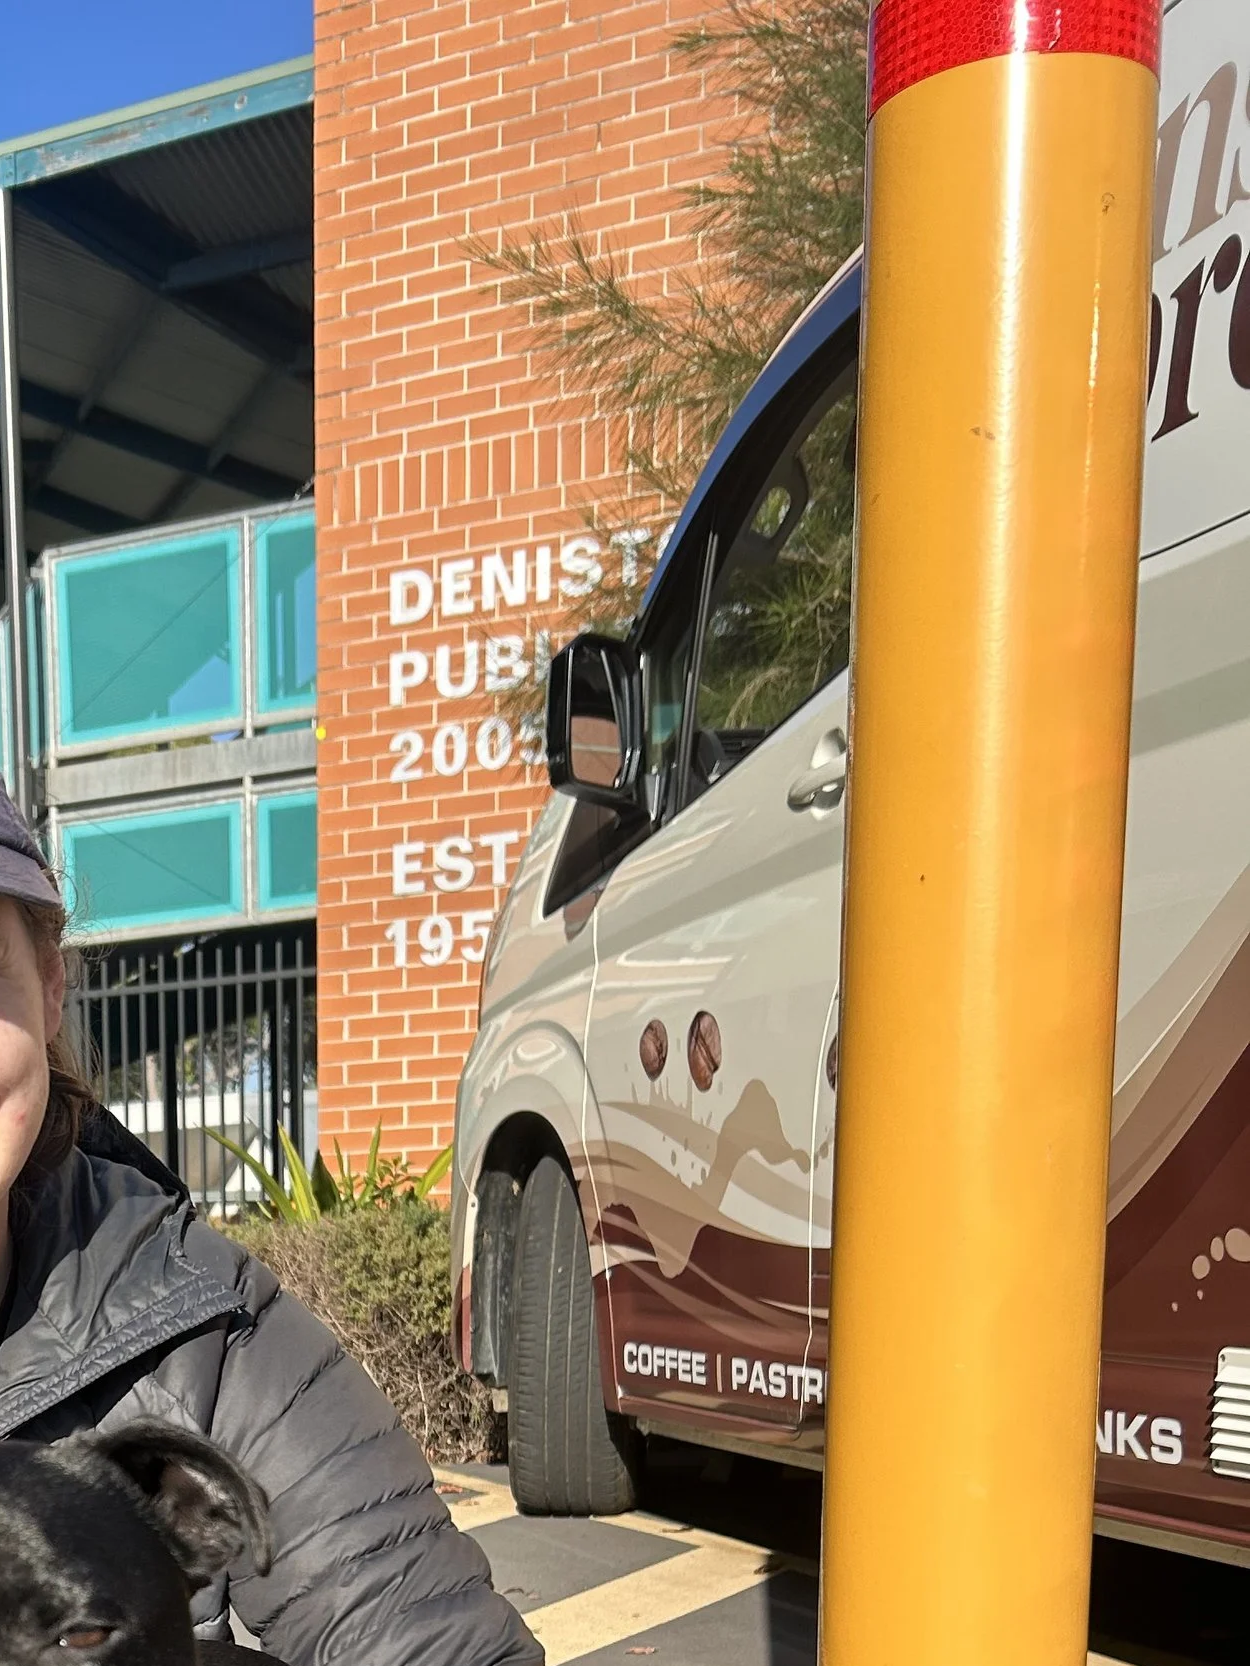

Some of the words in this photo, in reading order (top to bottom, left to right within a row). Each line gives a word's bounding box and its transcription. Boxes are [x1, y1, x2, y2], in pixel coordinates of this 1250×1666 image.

[391, 831, 519, 896] EST
[623, 1341, 707, 1386] COFFEE
[731, 1357, 828, 1404] PASTR
